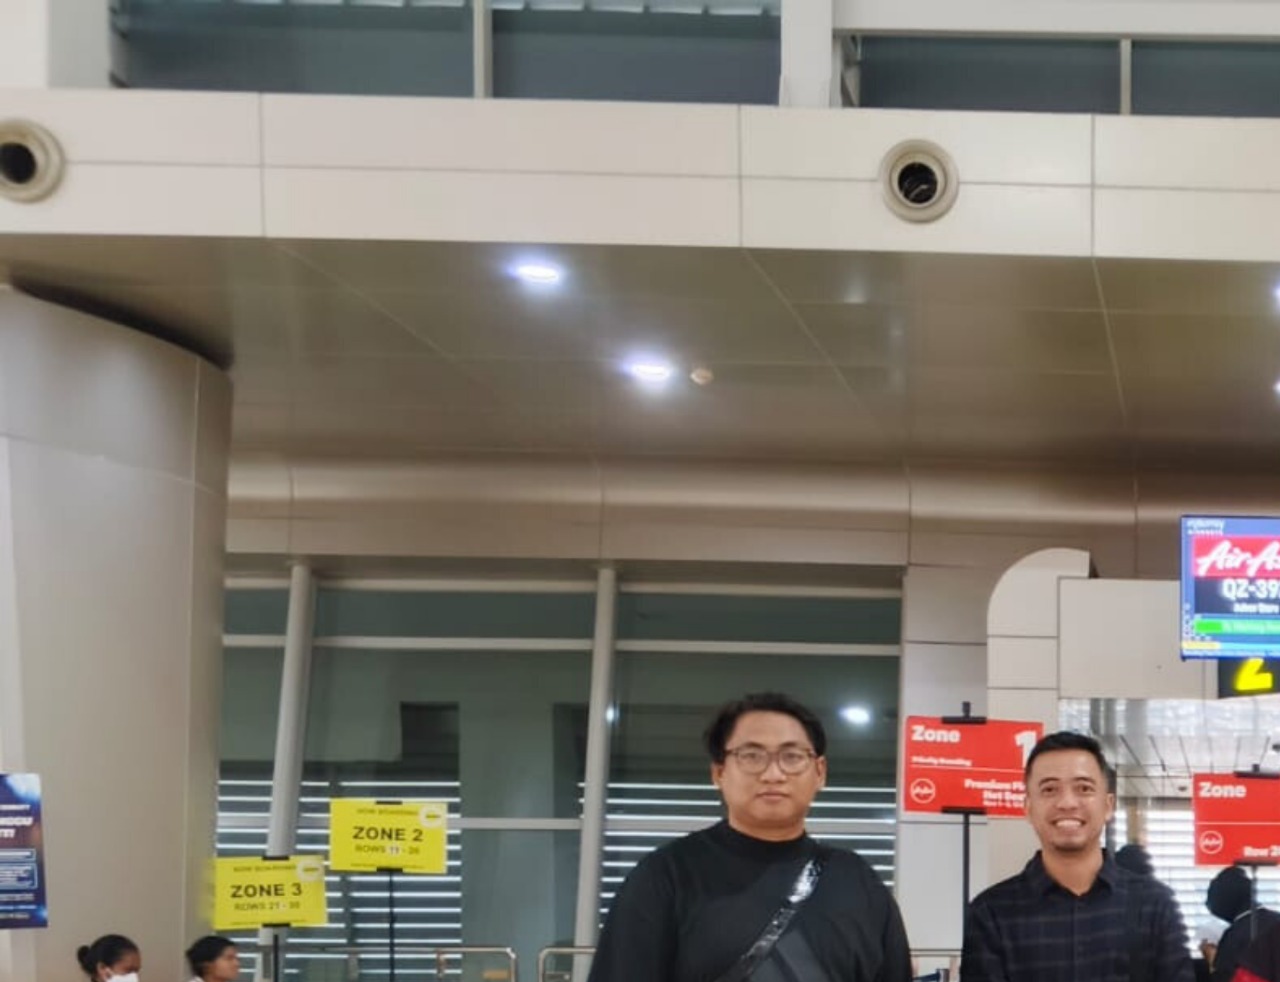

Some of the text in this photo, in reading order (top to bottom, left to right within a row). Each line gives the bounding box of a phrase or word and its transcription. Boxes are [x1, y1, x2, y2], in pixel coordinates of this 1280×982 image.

[911, 725, 1037, 769] Zone 1
[1198, 781, 1247, 798] Zone
[352, 826, 424, 843] ZONE 2
[1243, 846, 1269, 857] Row
[230, 882, 302, 899] ZONE 3
